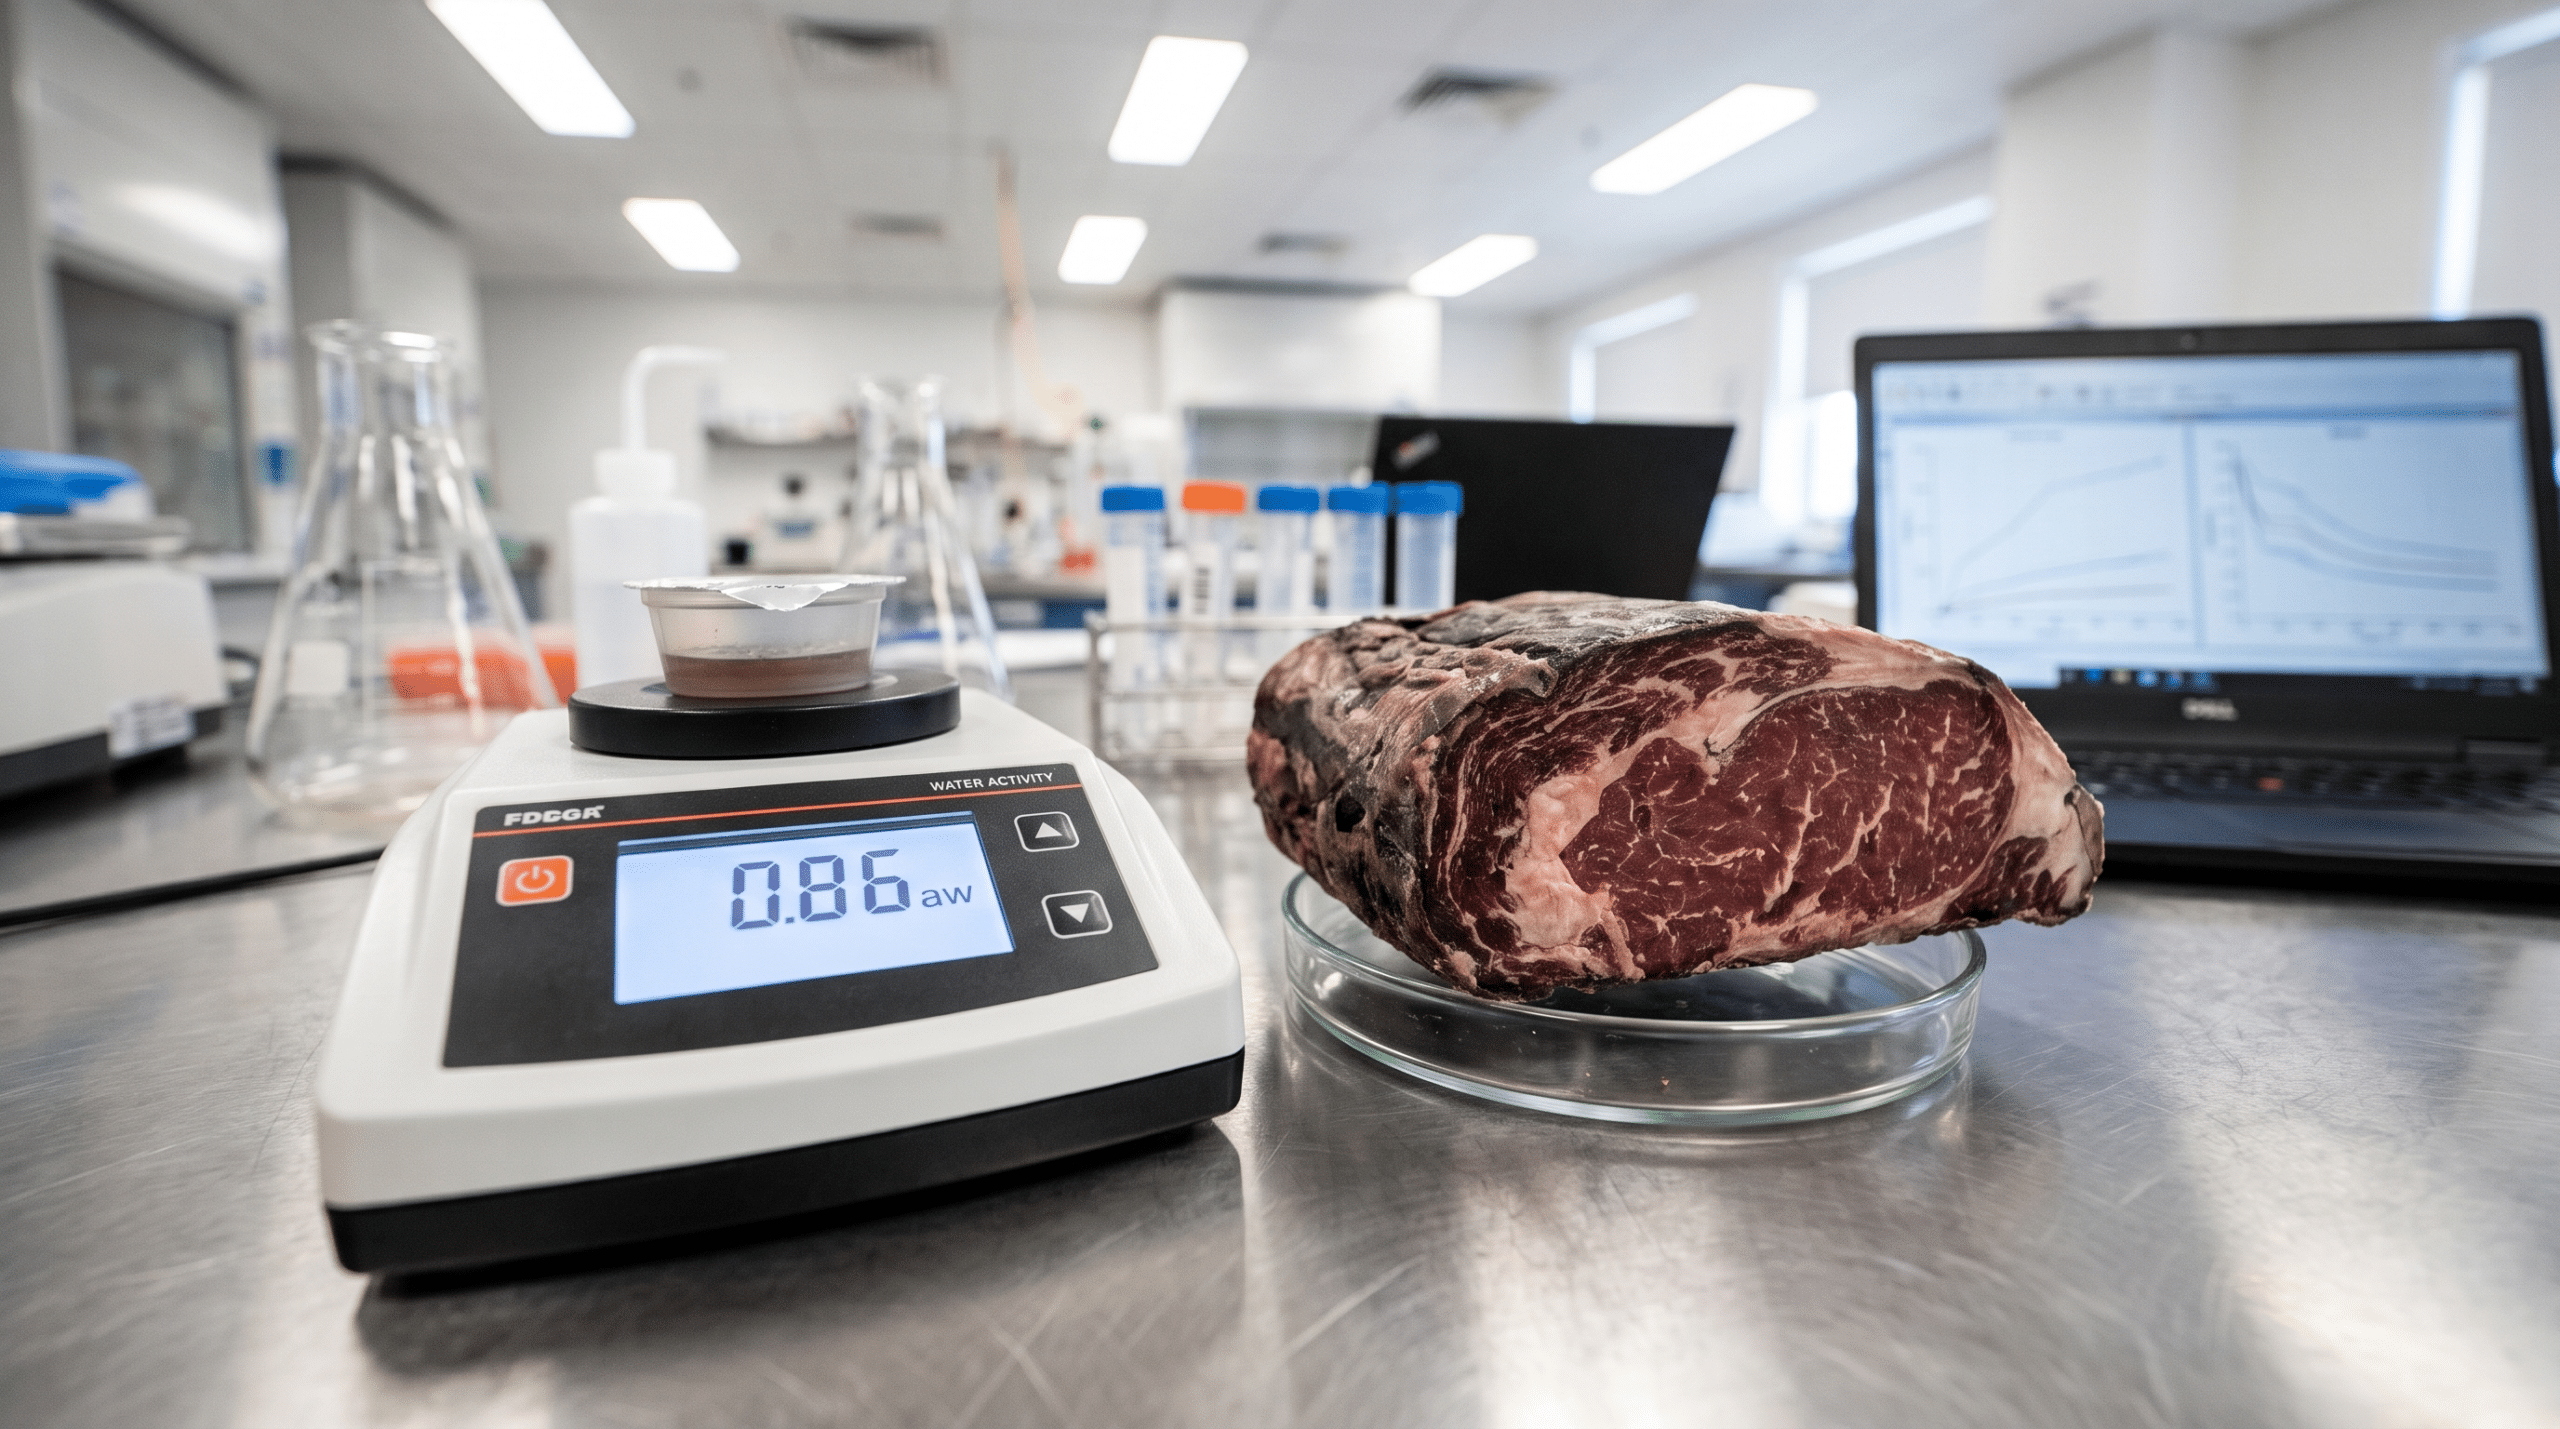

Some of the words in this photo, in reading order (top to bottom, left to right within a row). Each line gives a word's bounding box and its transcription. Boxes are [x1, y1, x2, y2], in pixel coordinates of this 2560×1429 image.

[929, 778, 984, 791] WATER
[988, 772, 1053, 787] ACTIVITY
[731, 848, 911, 930] 0.86
[921, 885, 972, 908] aw
